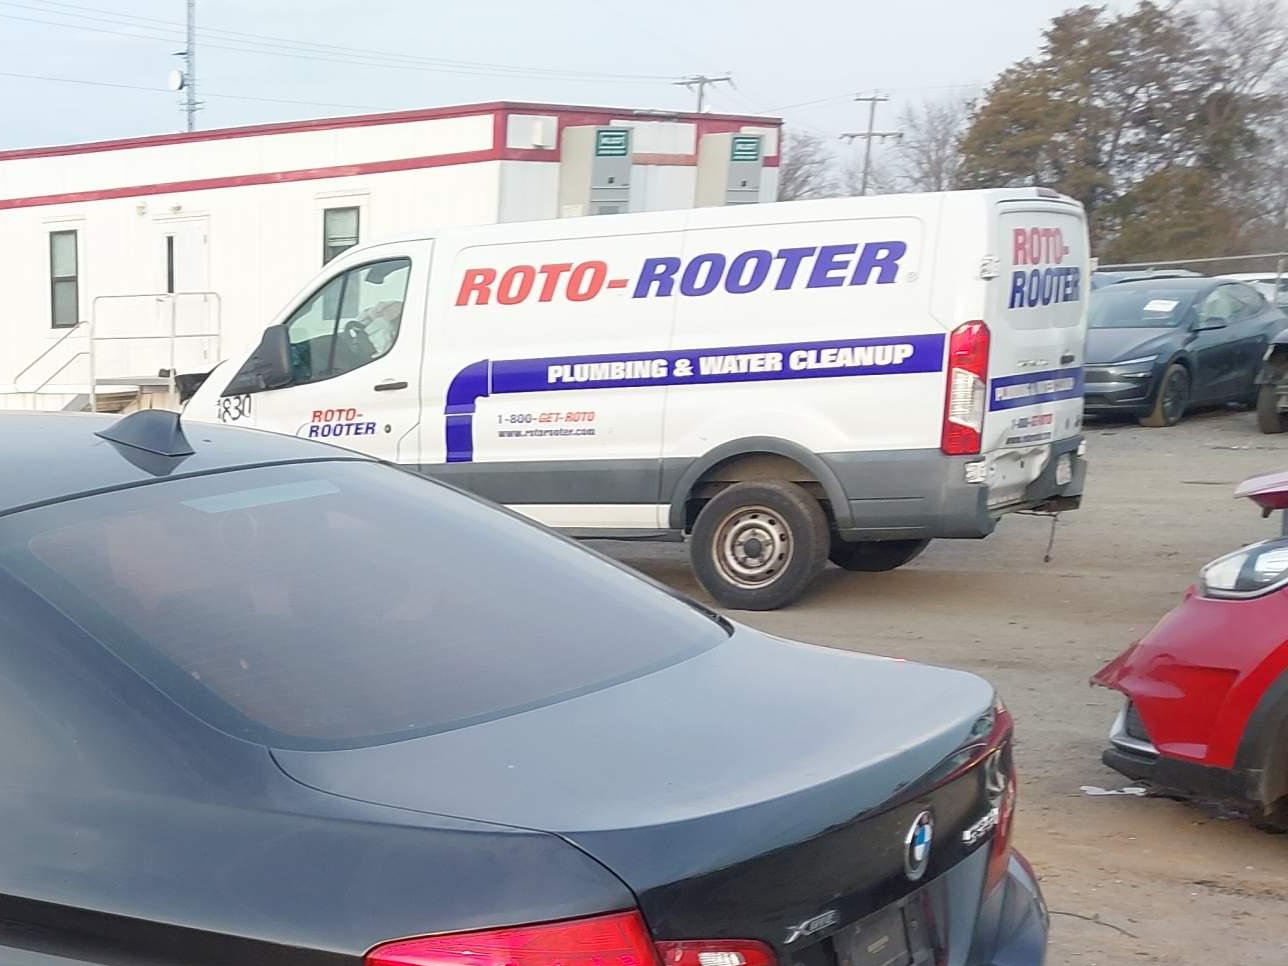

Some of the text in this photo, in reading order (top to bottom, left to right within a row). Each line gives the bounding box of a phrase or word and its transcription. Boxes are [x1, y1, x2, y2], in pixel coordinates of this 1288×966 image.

[1012, 227, 1069, 265] ROTO-
[455, 240, 907, 306] ROTO-ROOTER
[1008, 267, 1080, 309] ROOTER
[547, 344, 914, 383] PLUMBING & WATER CLEANUP
[308, 422, 376, 438] ROOTER
[312, 408, 363, 422] ROTO-
